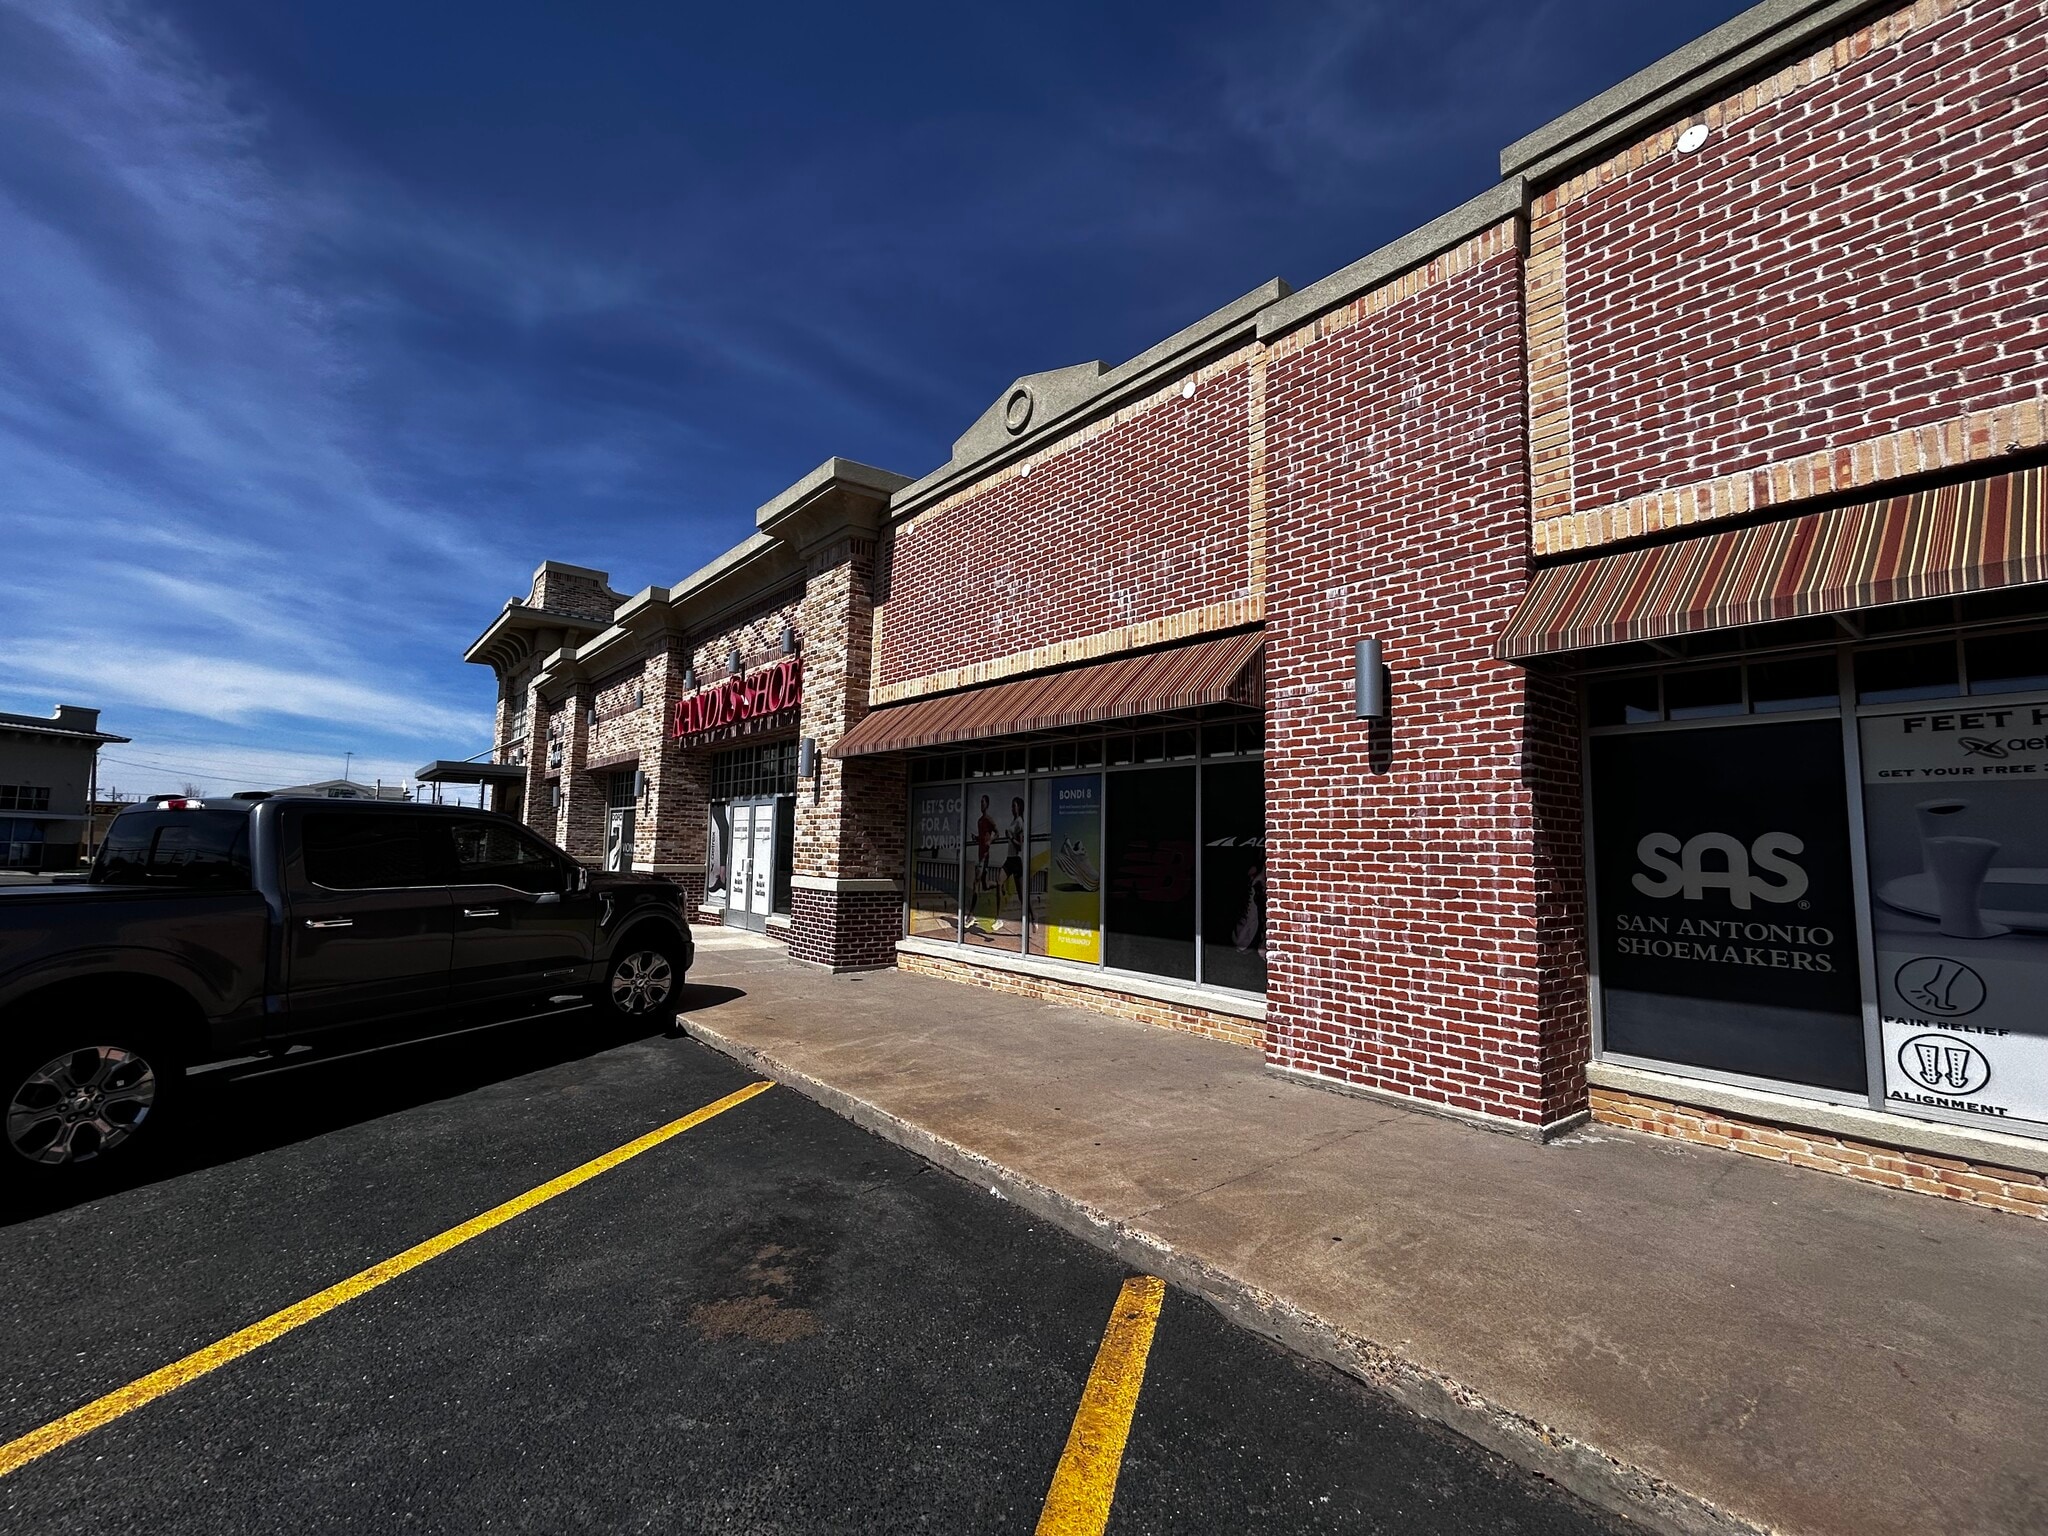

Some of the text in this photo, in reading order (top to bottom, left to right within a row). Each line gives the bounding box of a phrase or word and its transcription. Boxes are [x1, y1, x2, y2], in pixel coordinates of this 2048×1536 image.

[741, 659, 802, 720] SHOE
[1903, 711, 2013, 733] FEET
[1878, 769, 1915, 778] GET
[1921, 767, 1975, 776] YOUR
[1983, 764, 2036, 775] FREE
[1059, 788, 1092, 800] BONDI 8
[922, 797, 962, 814] LET'S GO
[921, 816, 950, 831] FOR A
[1631, 831, 1809, 910] SAS
[1616, 914, 1834, 946] SAN ANTONIO
[1616, 936, 1833, 974] SHOEMAKERS
[1884, 1015, 2010, 1036] PAIN RELIEF
[1890, 1090, 2008, 1116] ALIGNMENT
